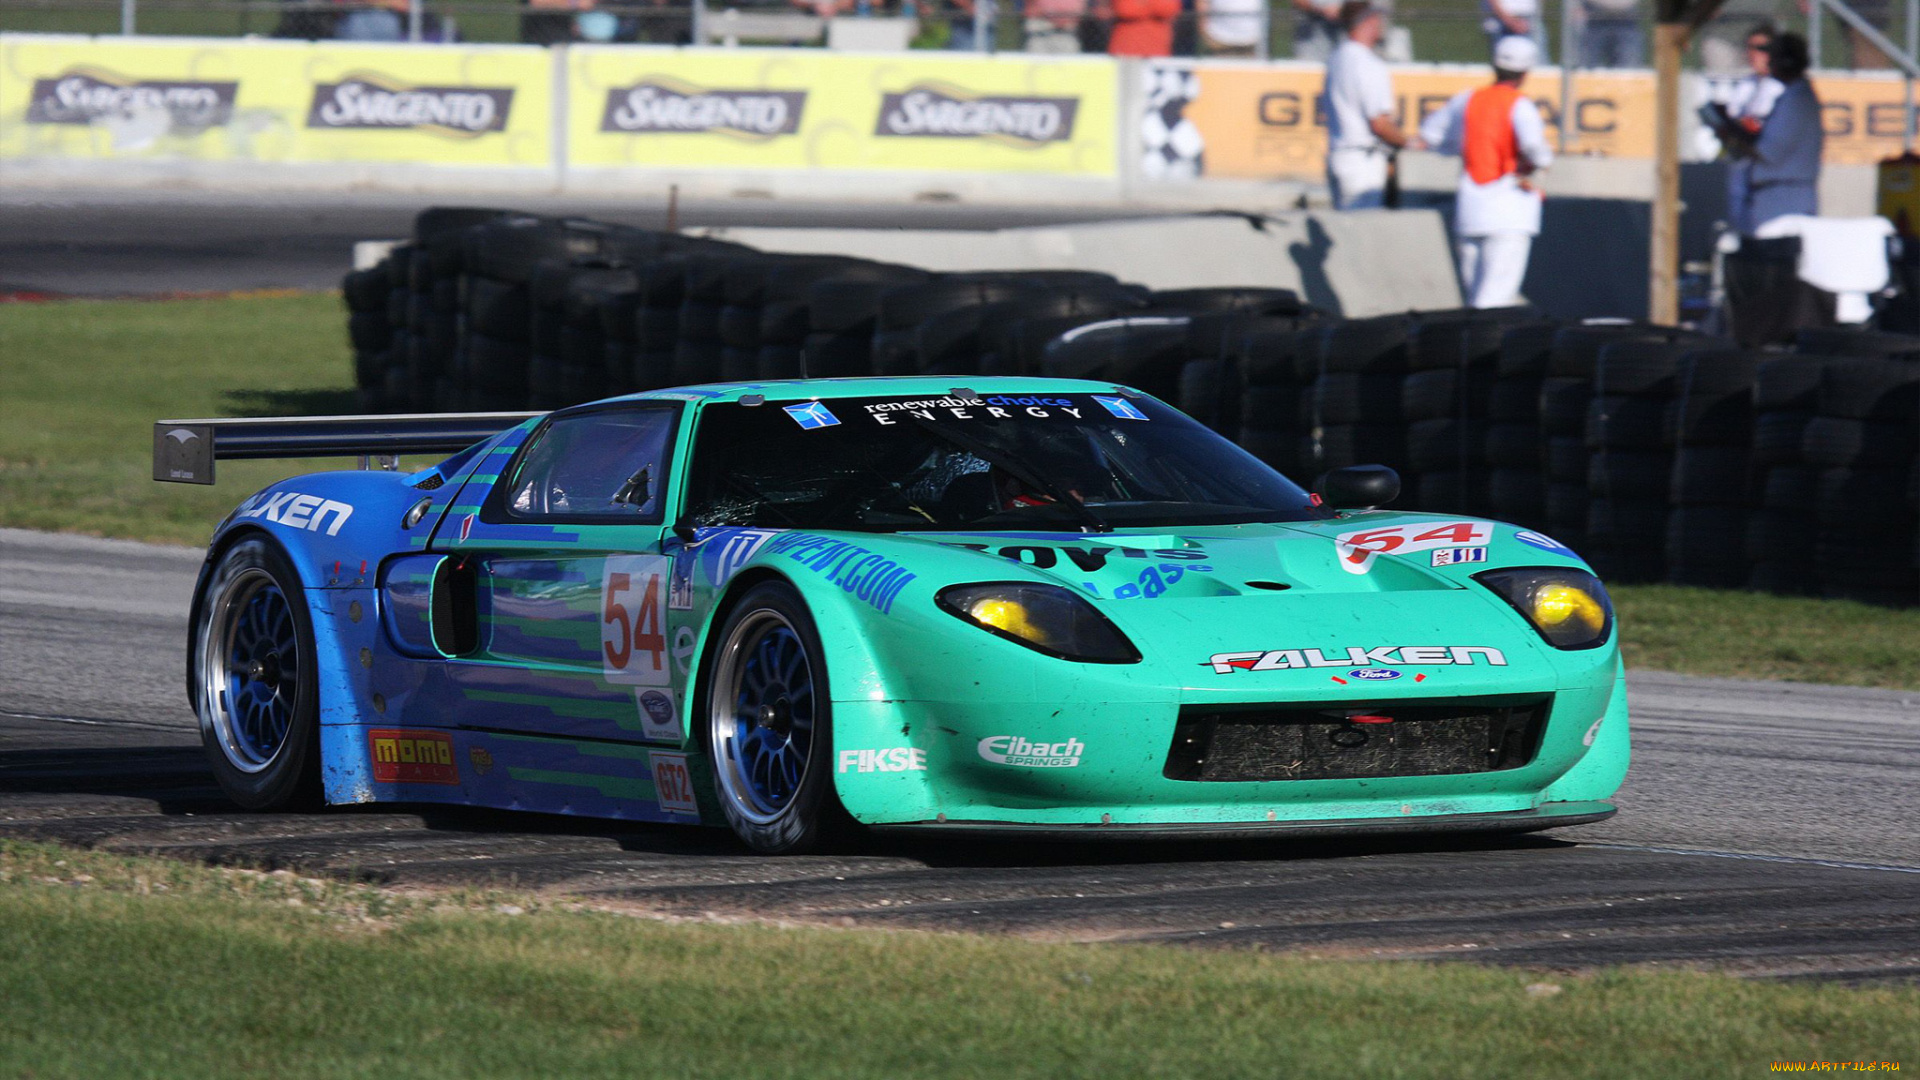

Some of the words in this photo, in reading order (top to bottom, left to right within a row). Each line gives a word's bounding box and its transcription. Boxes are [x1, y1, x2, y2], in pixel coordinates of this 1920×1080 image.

[321, 82, 495, 131] SARGENTO
[614, 87, 788, 133] SARGENTO
[888, 92, 1061, 140] SARGENTO
[864, 396, 986, 413] renewable
[986, 395, 1073, 407] choice
[873, 406, 1083, 425] ENERGY
[1343, 522, 1483, 564] 54
[604, 572, 666, 671] 54
[1199, 646, 1508, 675] FALKEN
[1358, 668, 1393, 678] Ford
[838, 747, 928, 774] FIKSE
[977, 735, 1085, 767] Eibach
[1005, 756, 1073, 767] SPRINGS
[656, 761, 693, 803] GT2
